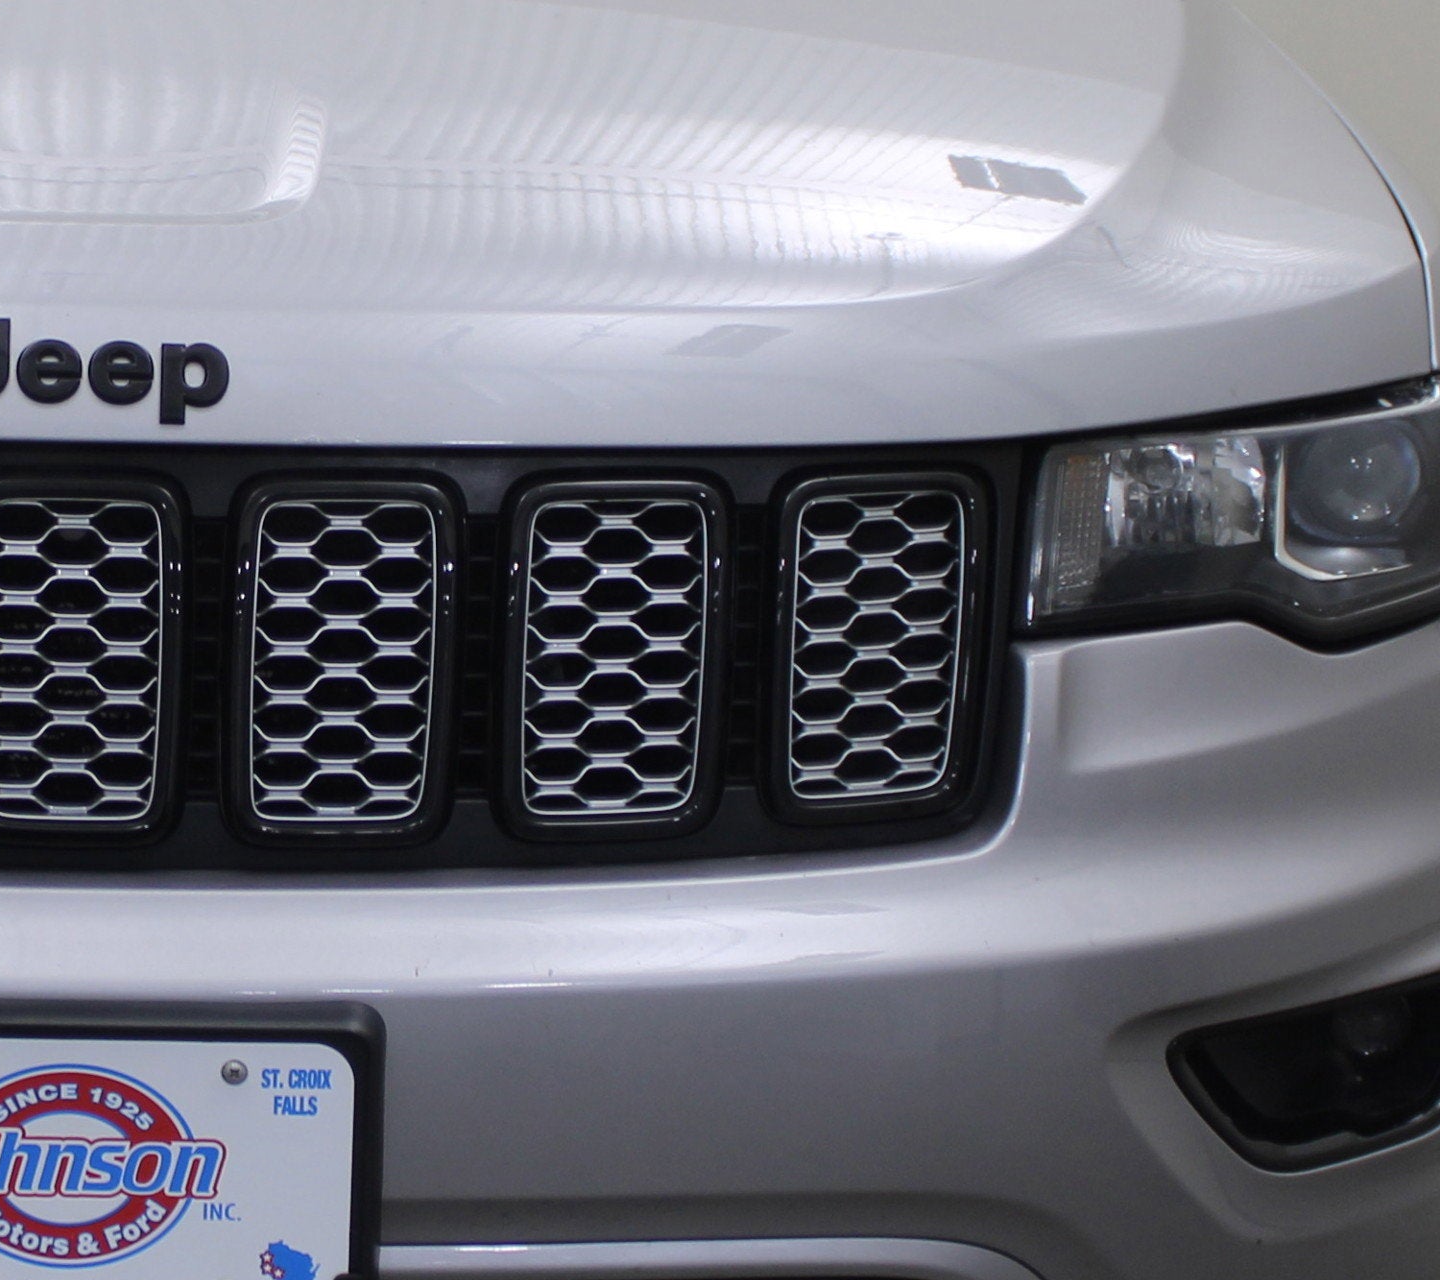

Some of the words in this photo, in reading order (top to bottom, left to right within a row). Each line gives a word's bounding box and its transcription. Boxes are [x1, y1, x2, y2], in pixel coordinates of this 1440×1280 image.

[260, 1067, 285, 1090] ST.
[287, 1068, 333, 1091] CROIX
[90, 1087, 154, 1131] 1925
[273, 1095, 319, 1117] FALLS
[202, 1203, 242, 1223] INC.
[76, 1232, 101, 1257] &
[103, 1199, 169, 1251] Ford
